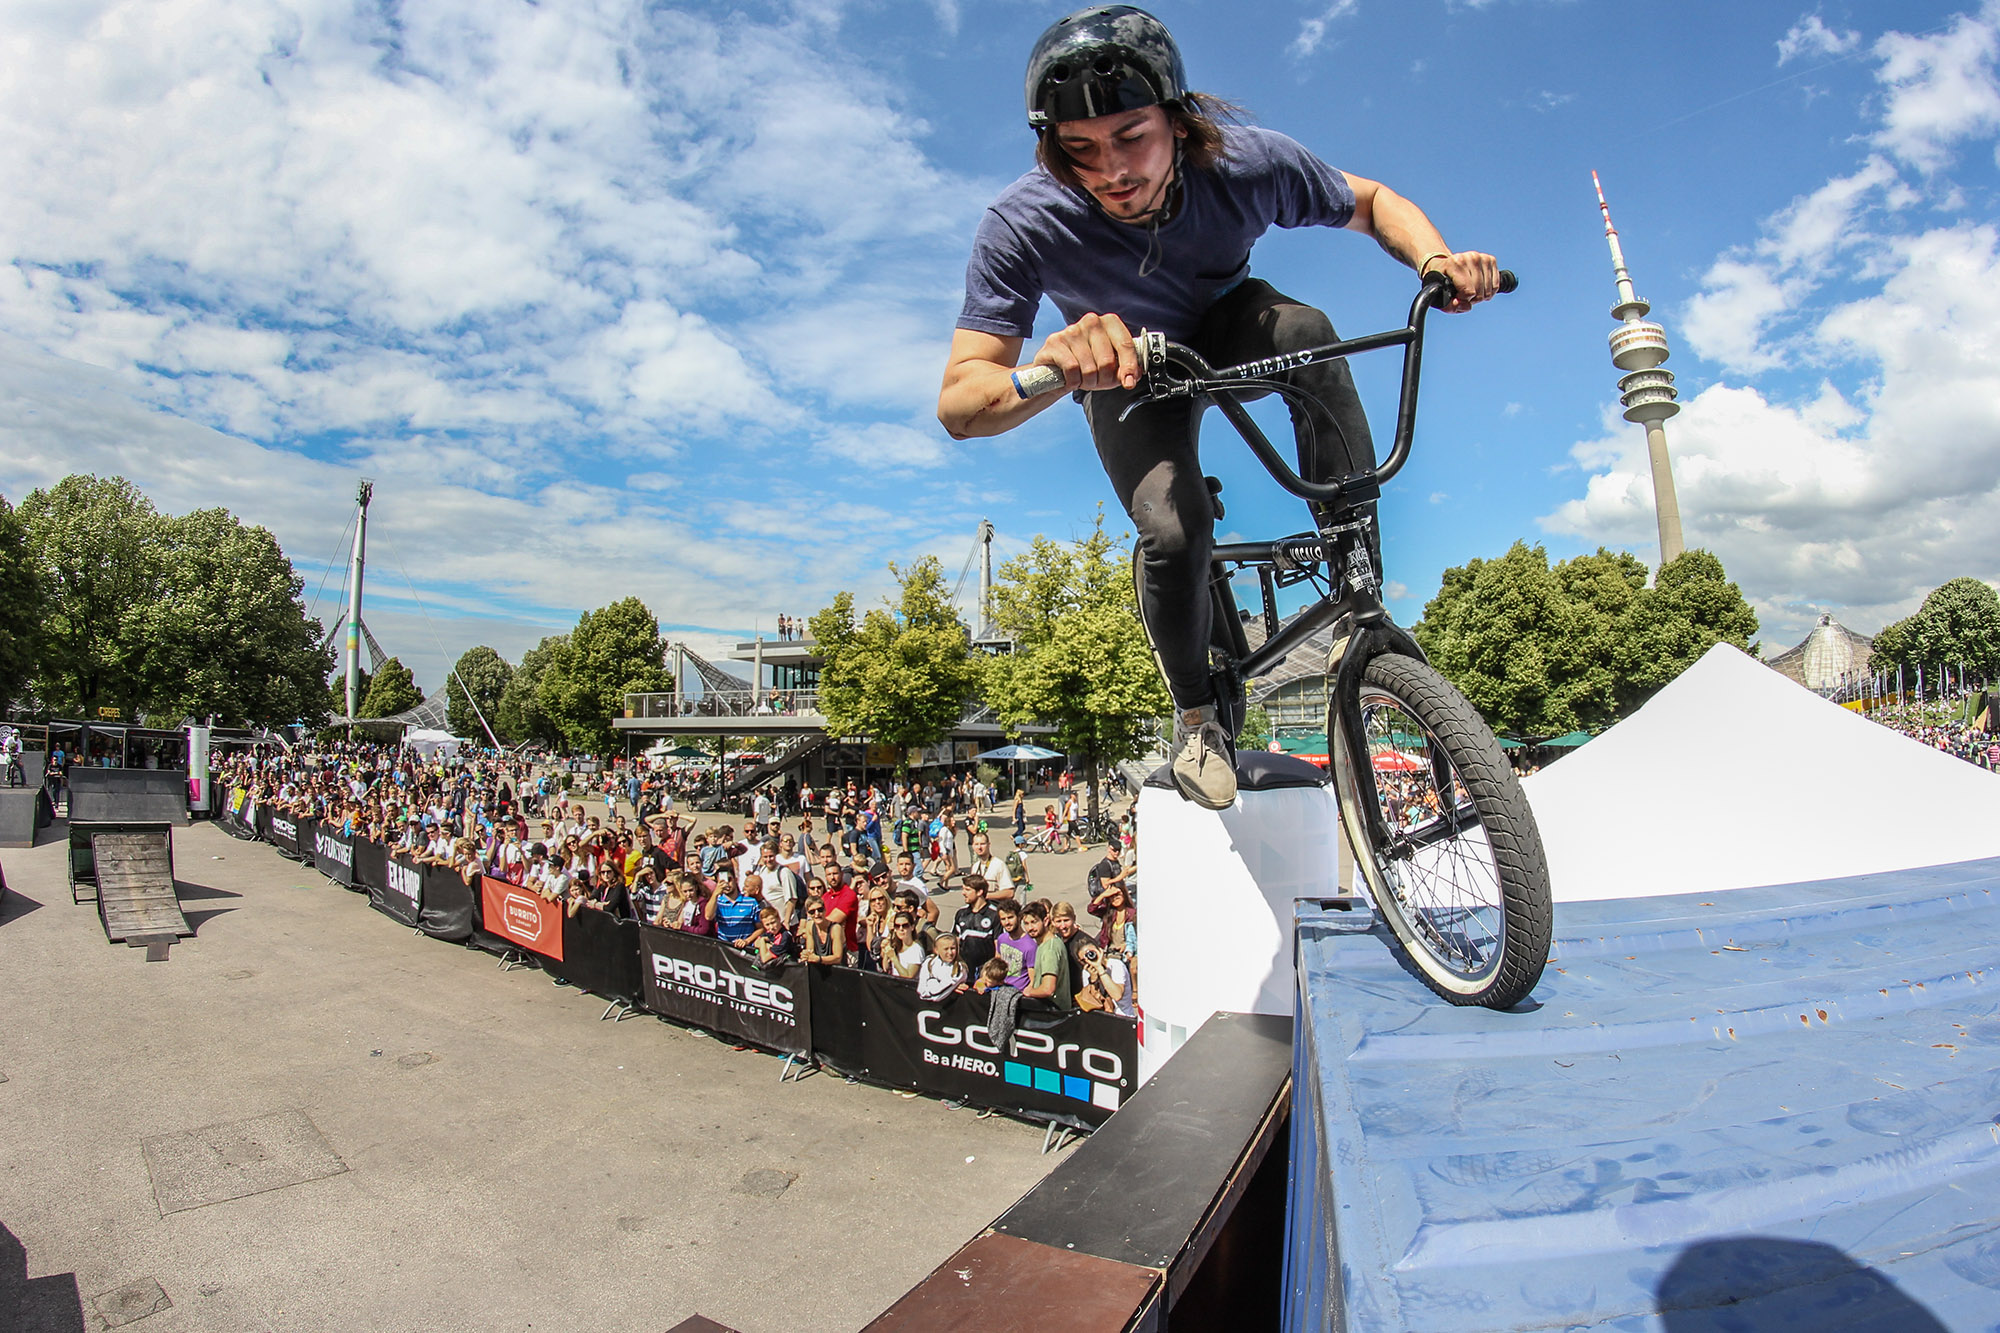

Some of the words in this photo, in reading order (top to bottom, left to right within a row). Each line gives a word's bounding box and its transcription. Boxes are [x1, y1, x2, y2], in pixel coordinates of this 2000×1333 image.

[1236, 354, 1296, 379] VOCAL
[509, 905, 538, 924] BURRITO
[652, 953, 794, 1013] PRO-TEC
[655, 979, 673, 991] THE
[677, 985, 724, 1006] ORIGINAL
[729, 1000, 763, 1017] SINCE
[770, 1012, 796, 1027] 1973
[923, 1048, 939, 1065] Be
[941, 1056, 950, 1067] a
[951, 1054, 1000, 1078] HERO.
